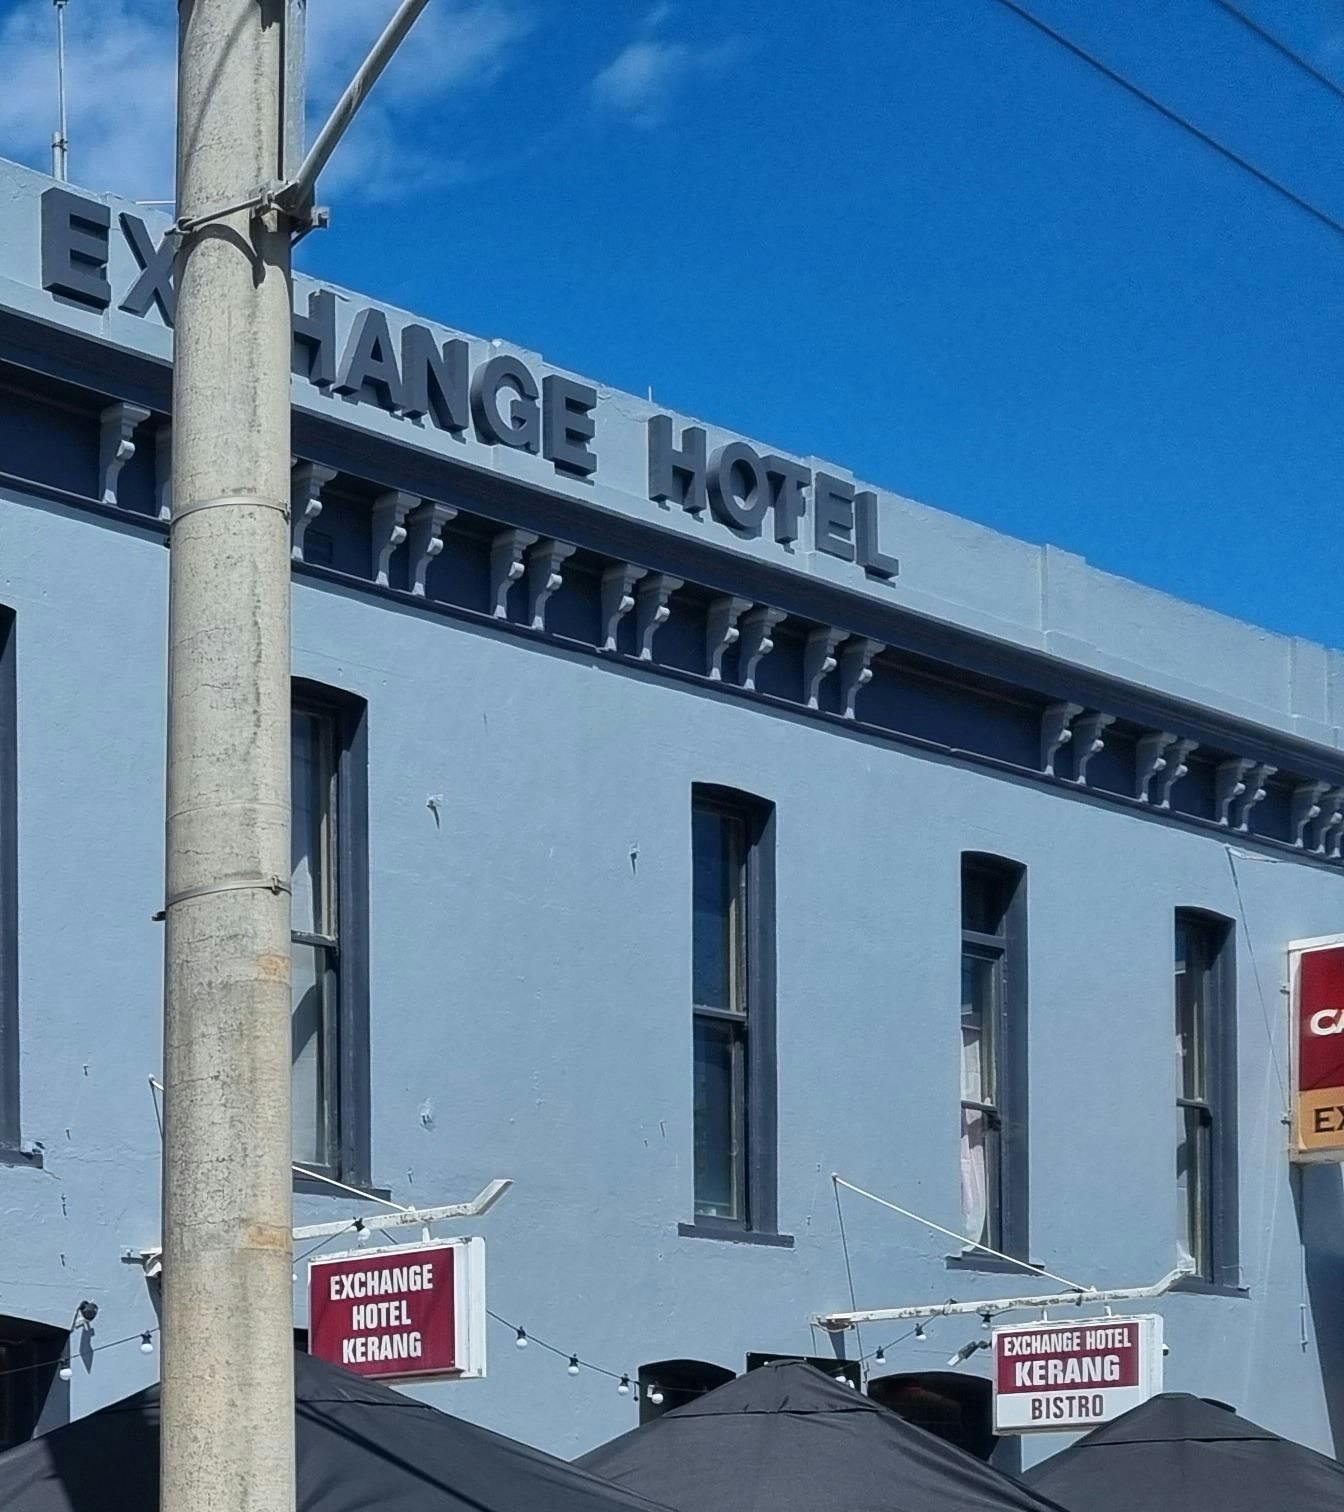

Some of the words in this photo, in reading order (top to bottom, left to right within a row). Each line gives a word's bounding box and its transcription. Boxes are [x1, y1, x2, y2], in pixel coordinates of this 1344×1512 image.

[41, 187, 598, 480] EXHANGE
[648, 413, 901, 581] HOTEL
[330, 1263, 433, 1301] EXCHANGE
[352, 1299, 412, 1331] HOTEL
[342, 1331, 422, 1364] KERANG
[1003, 1331, 1081, 1357] EXCHANGE
[1085, 1327, 1132, 1349] HOTEL
[1015, 1354, 1120, 1387] KERANG
[1031, 1394, 1104, 1420] BISTRO
